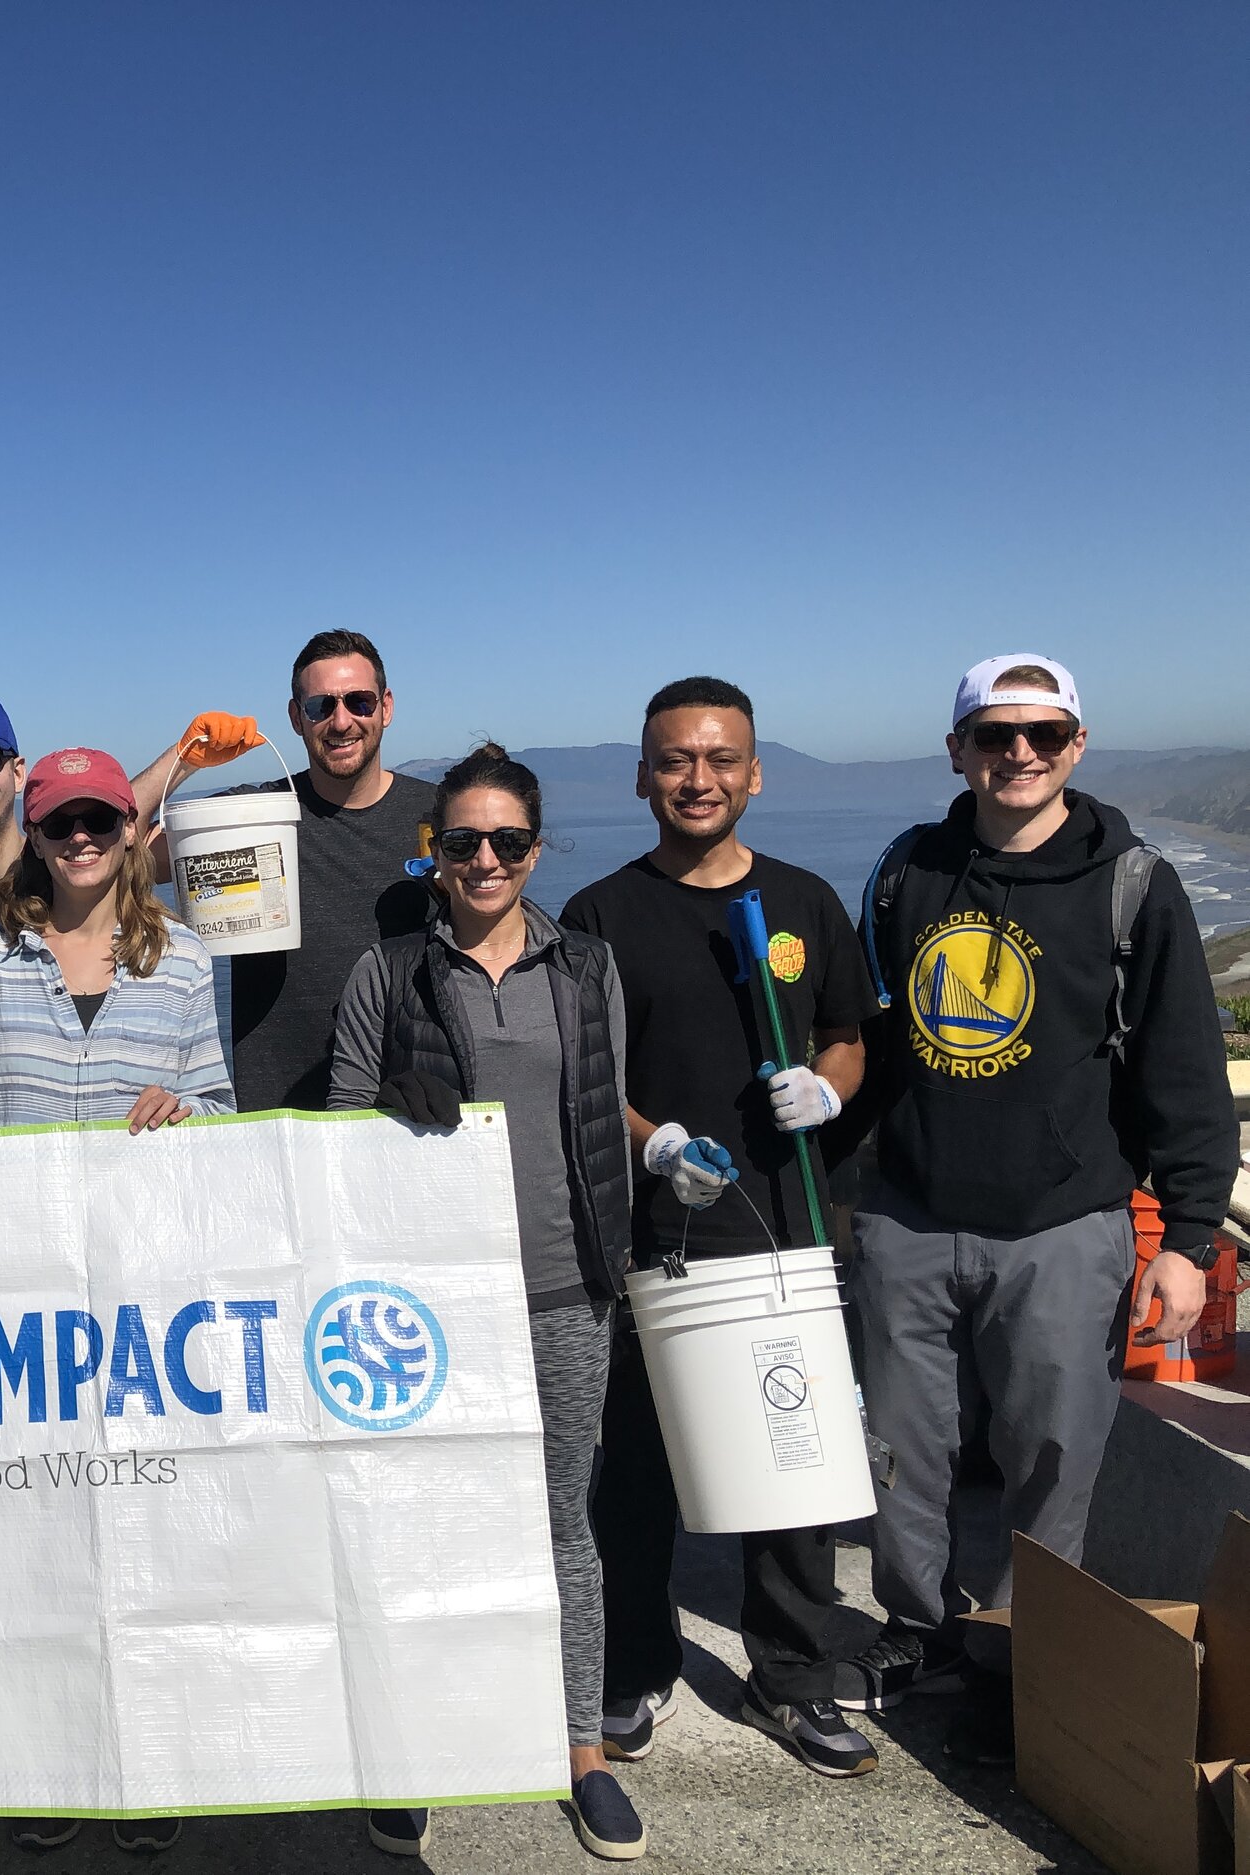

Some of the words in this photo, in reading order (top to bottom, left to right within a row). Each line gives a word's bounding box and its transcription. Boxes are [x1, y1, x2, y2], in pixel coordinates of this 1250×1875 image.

[194, 887, 224, 902] OREO
[196, 921, 224, 935] 13242
[914, 911, 988, 946] GOLDEN
[996, 916, 1043, 960] STATE
[774, 952, 805, 978] CRUZ
[909, 1024, 1032, 1078] WARRIORS
[764, 1340, 797, 1350] WARNING
[774, 1352, 794, 1362] AVISO
[40, 1449, 178, 1489] Works
